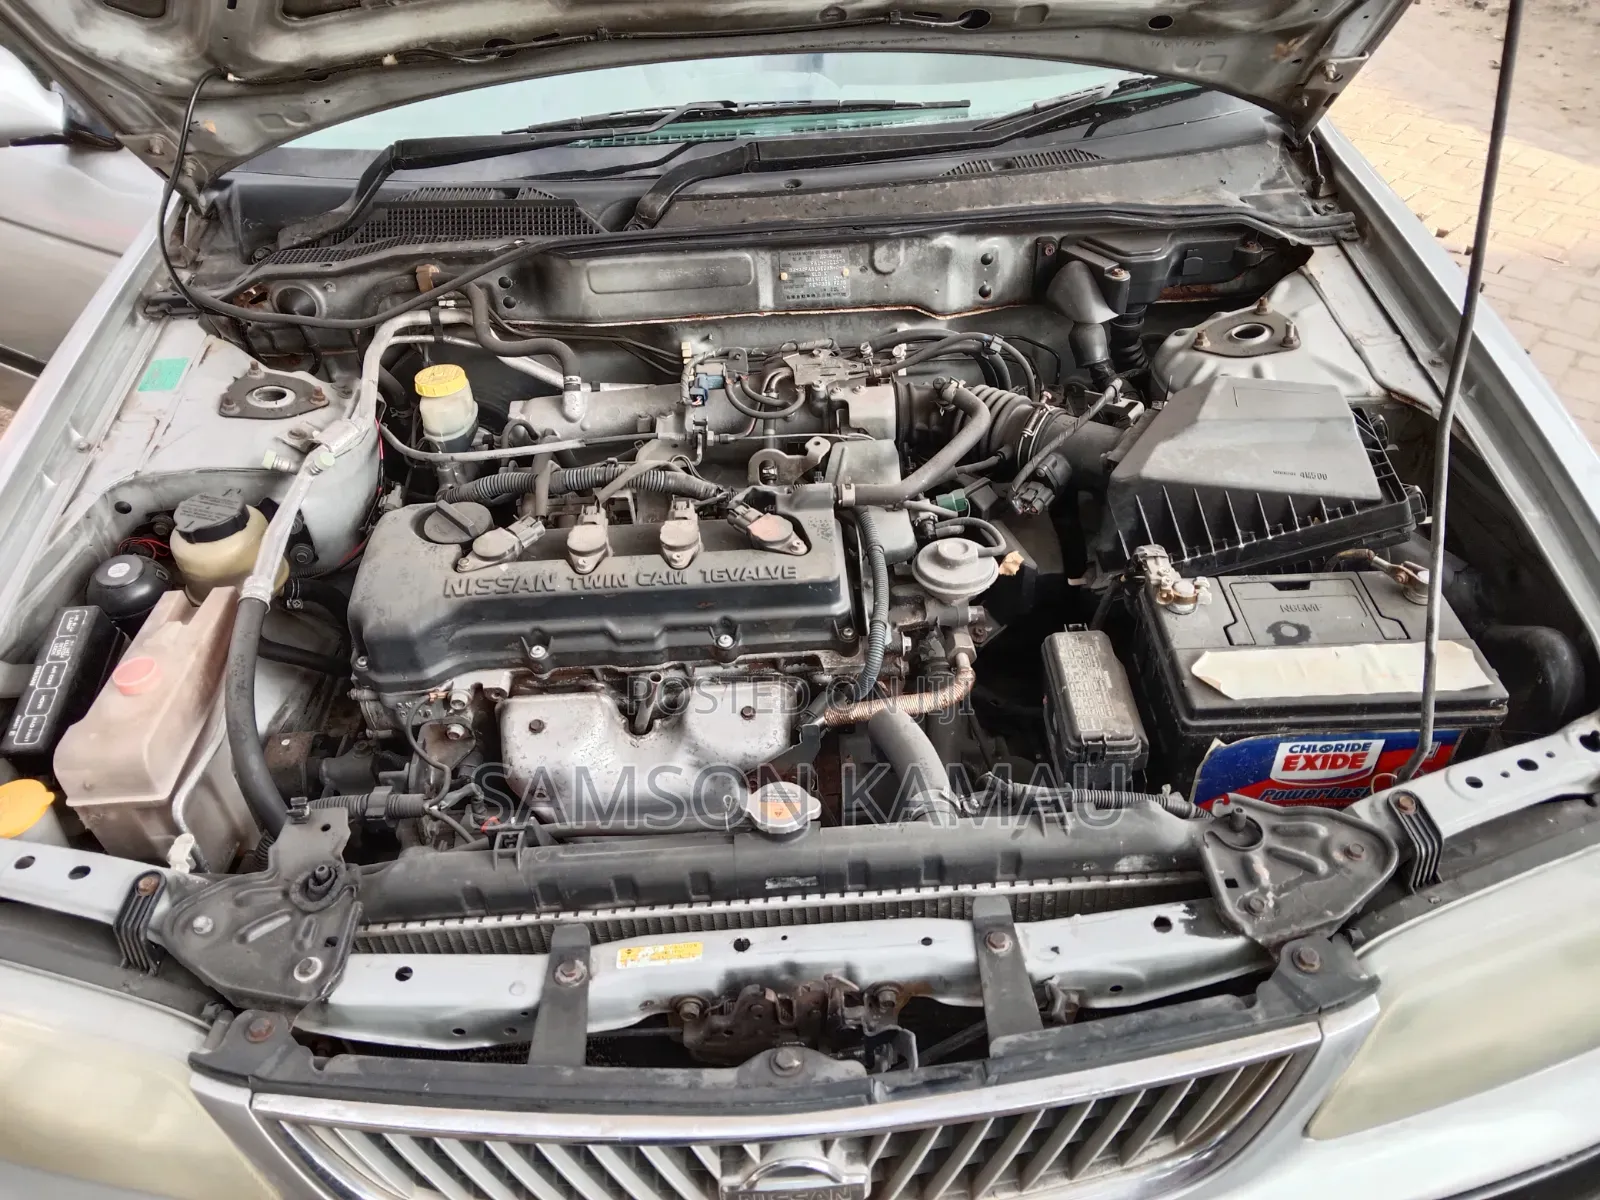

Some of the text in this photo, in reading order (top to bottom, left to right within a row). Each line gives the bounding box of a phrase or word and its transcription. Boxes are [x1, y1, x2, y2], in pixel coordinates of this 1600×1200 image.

[443, 574, 557, 599] NISSAN
[566, 573, 629, 591] TWIN
[636, 570, 688, 587] CAM
[1289, 742, 1371, 754] CHLORIDE
[1281, 752, 1368, 772] EXIDE
